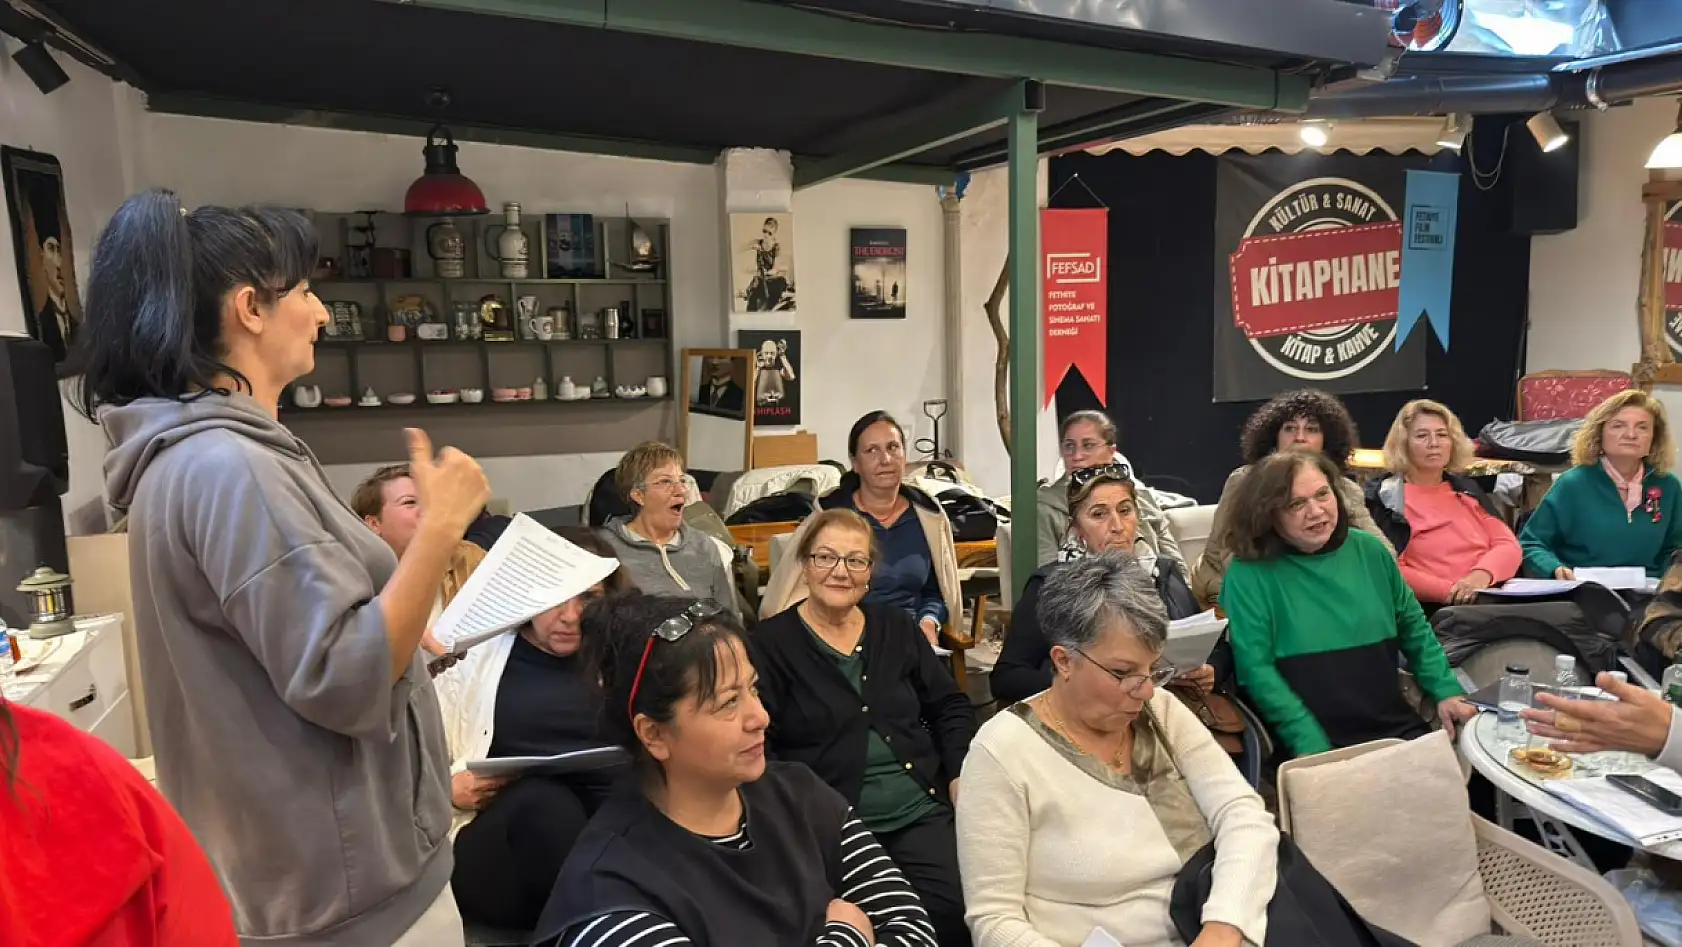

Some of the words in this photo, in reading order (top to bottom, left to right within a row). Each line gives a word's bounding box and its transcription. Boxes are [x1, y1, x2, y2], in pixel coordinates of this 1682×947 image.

[1268, 192, 1319, 233] KÜLTÜR
[1322, 193, 1331, 208] &
[1336, 192, 1377, 222] SANAT
[1051, 261, 1095, 275] FEFSAD
[1250, 250, 1401, 307] KİTAPHANE
[1280, 334, 1321, 364] KİTAP
[1324, 347, 1335, 365] &
[1336, 322, 1379, 362] KAHVE
